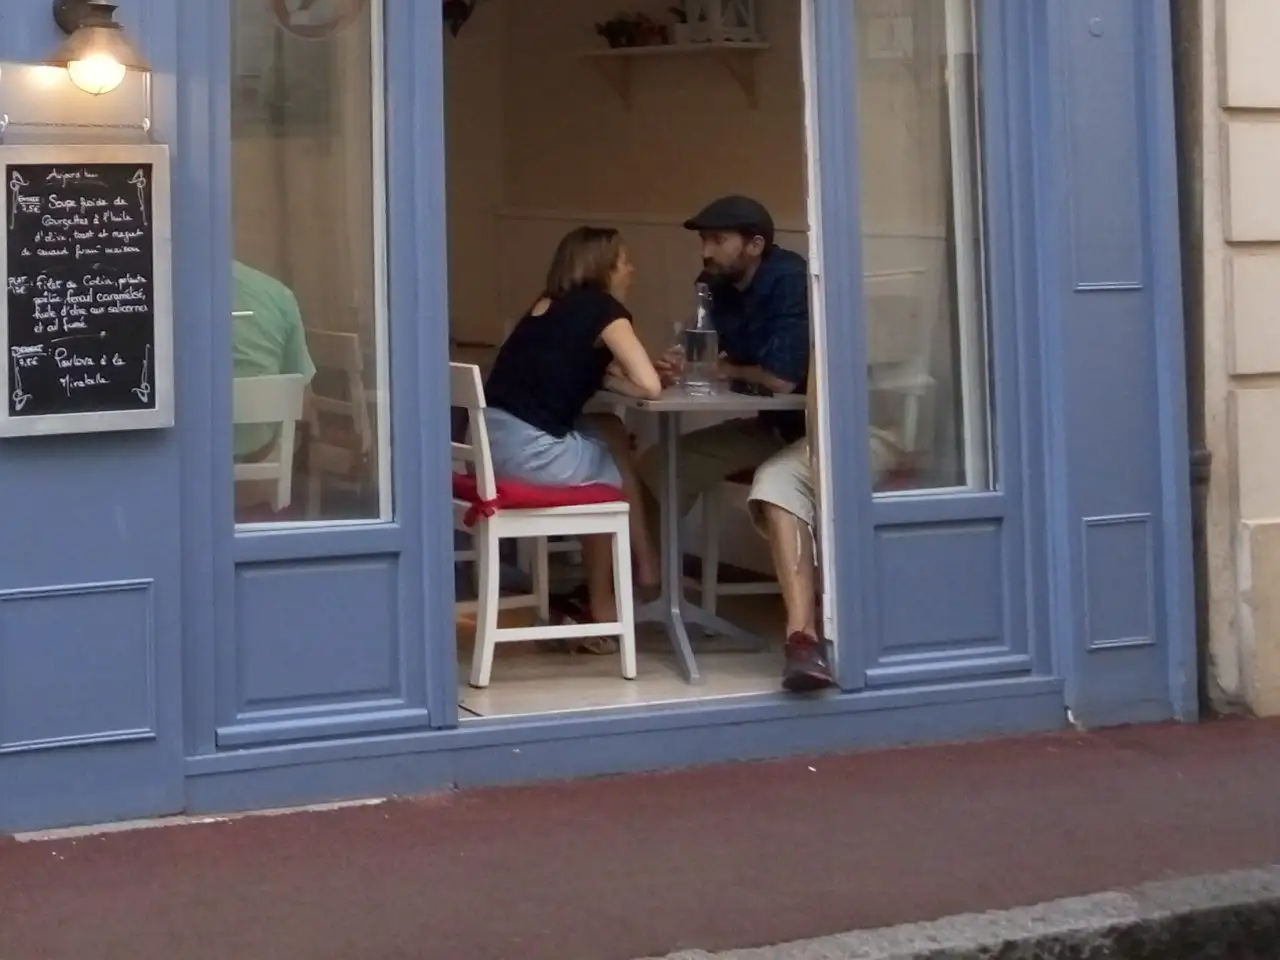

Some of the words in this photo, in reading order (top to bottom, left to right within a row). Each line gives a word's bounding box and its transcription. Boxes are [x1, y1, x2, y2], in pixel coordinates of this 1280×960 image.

[48, 194, 77, 211] Soupe
[114, 197, 128, 205] de
[98, 229, 109, 237] et
[34, 322, 44, 333] et
[55, 347, 96, 368] Pavlova
[112, 353, 126, 365] la
